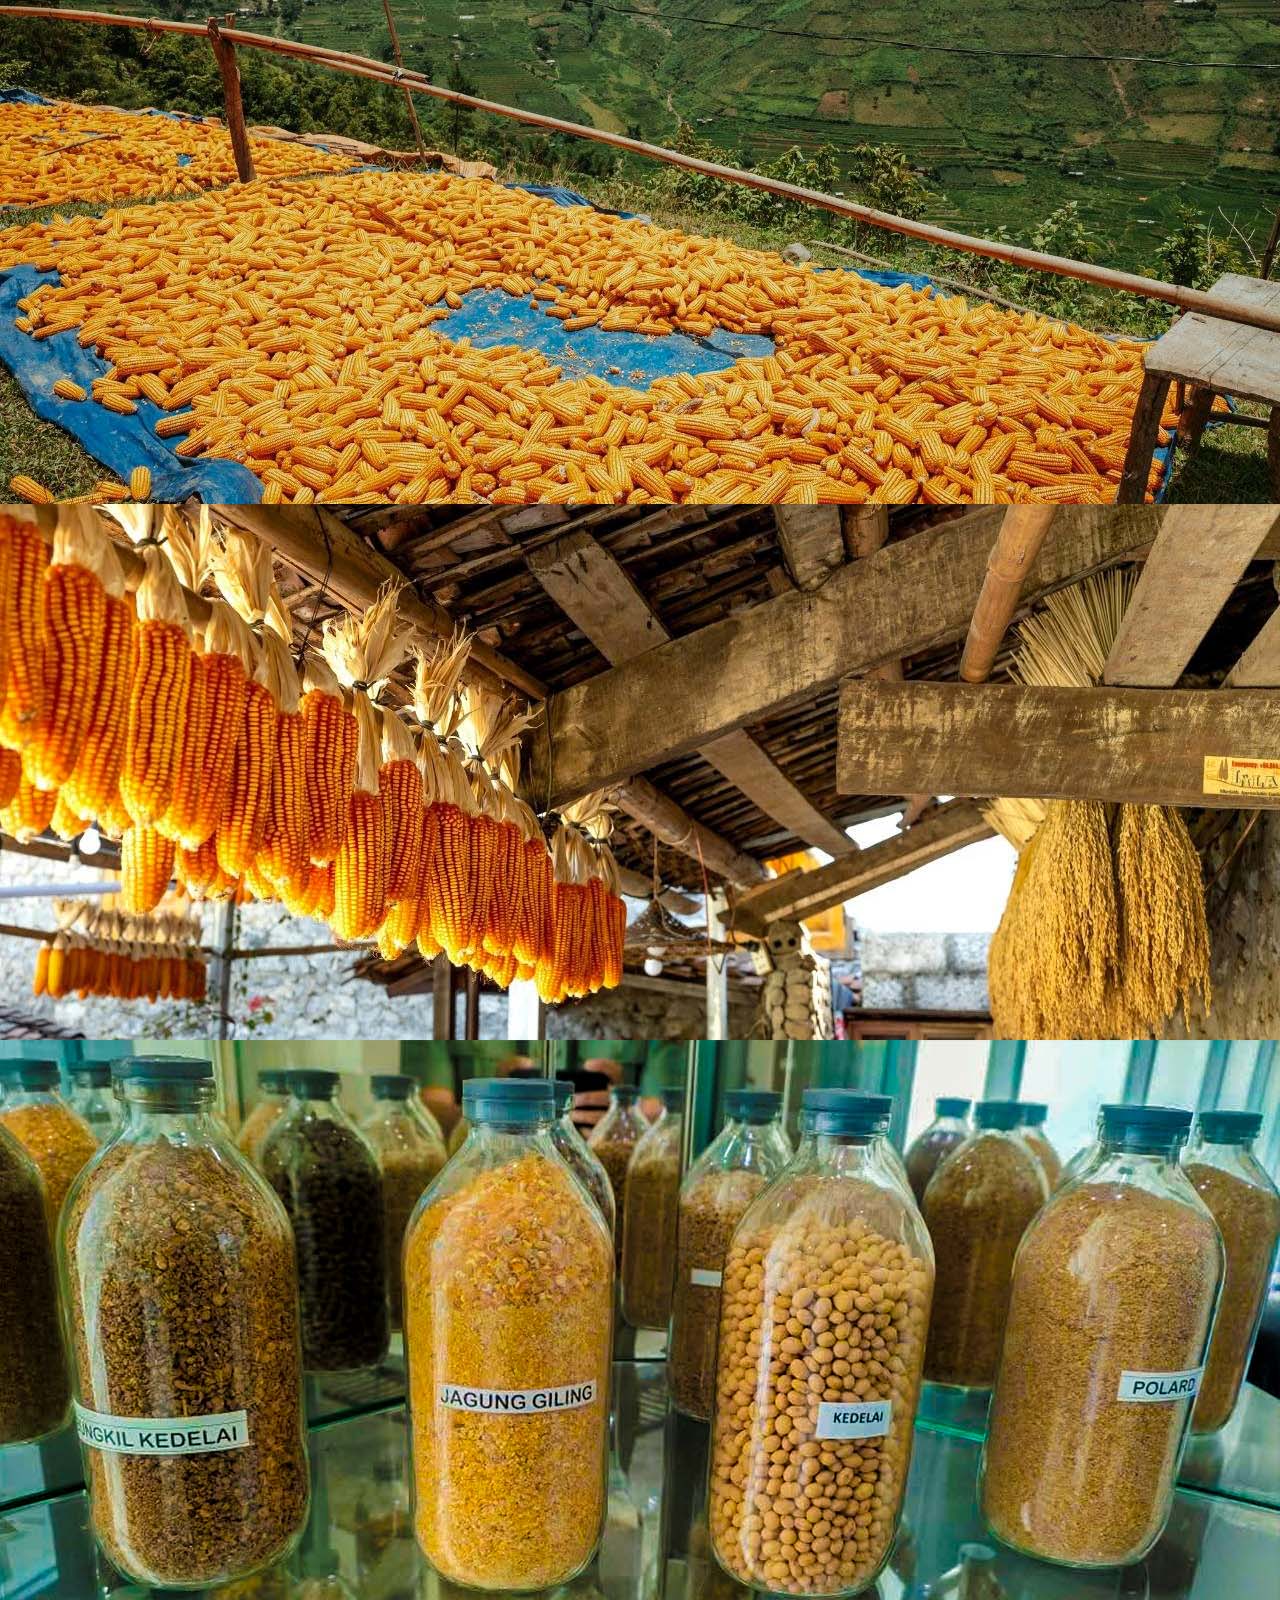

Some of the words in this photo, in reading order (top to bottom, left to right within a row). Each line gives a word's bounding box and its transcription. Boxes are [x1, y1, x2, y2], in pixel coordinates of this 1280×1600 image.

[1132, 1378, 1196, 1395] POLARD
[440, 1388, 526, 1410] JAGUNG
[532, 1385, 592, 1408] GILING
[833, 1411, 884, 1424] KEDELAI
[139, 1426, 237, 1448] KEDELAI
